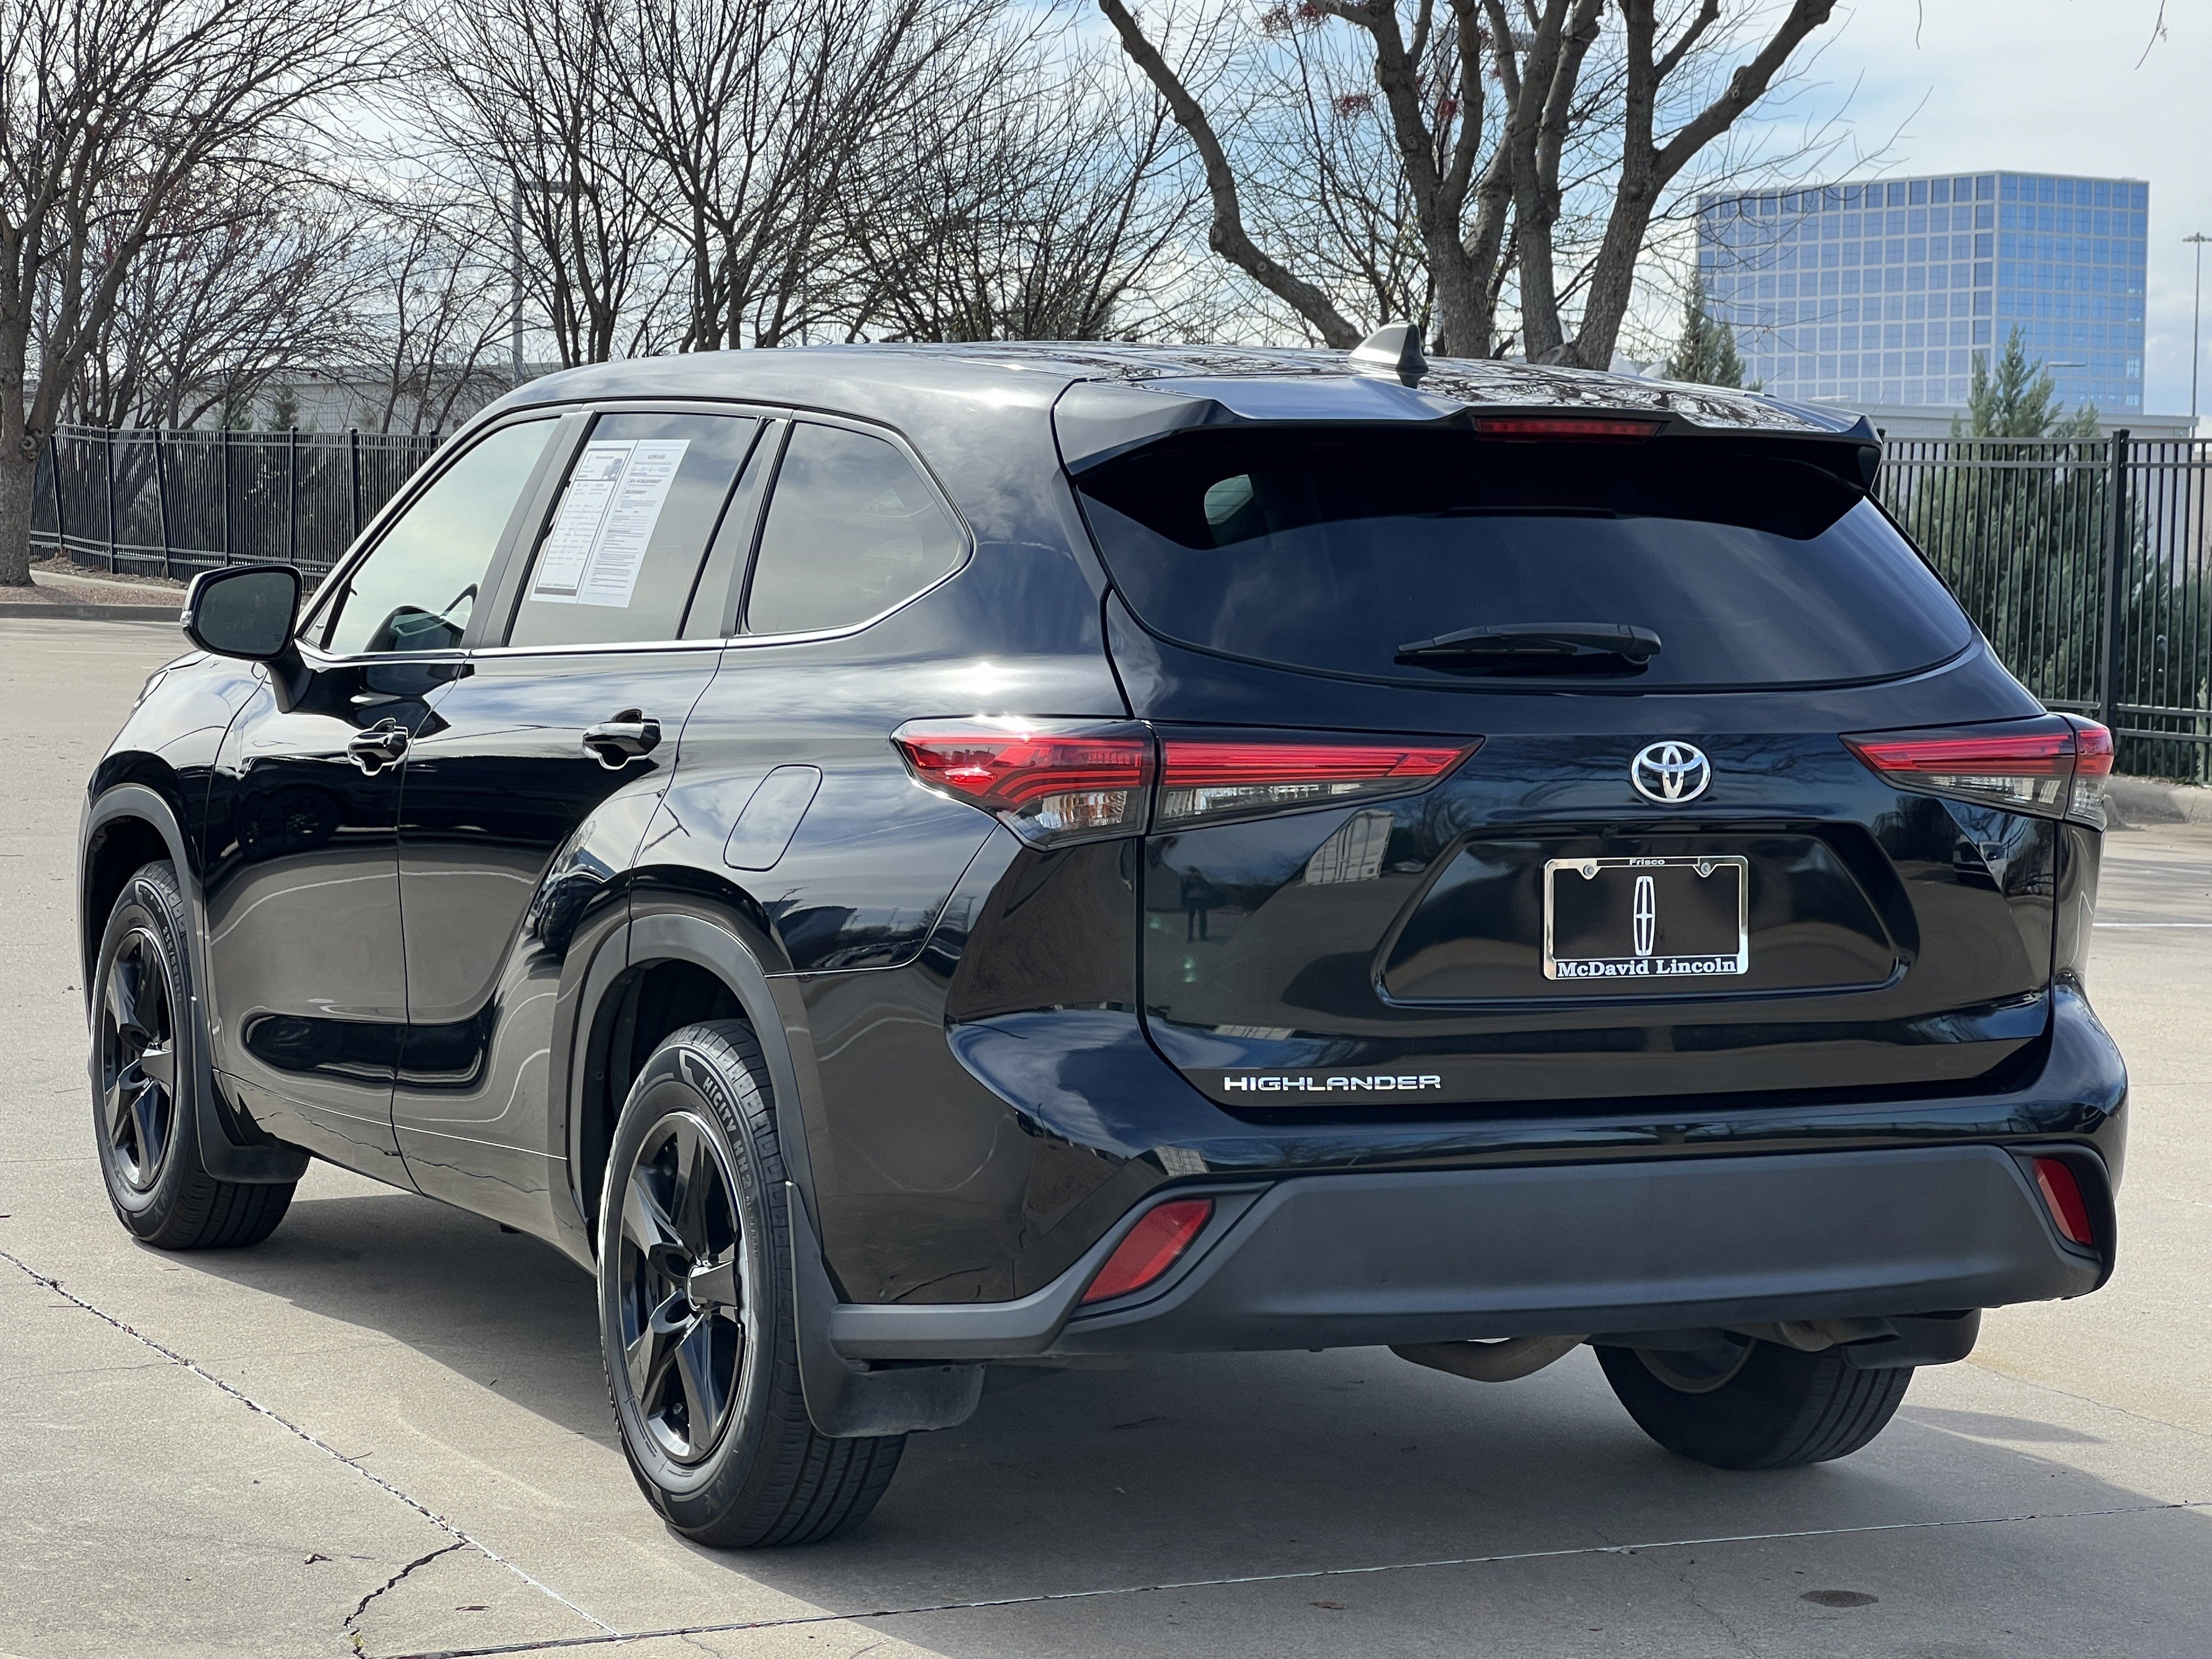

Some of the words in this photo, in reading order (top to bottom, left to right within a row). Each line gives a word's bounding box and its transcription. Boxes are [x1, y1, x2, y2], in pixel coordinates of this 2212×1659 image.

[1558, 960, 1649, 977] McDavid
[1656, 959, 1736, 974] Lincoln
[1224, 1075, 1441, 1091] HIGHLANDER
[733, 1139, 752, 1188] HH2
